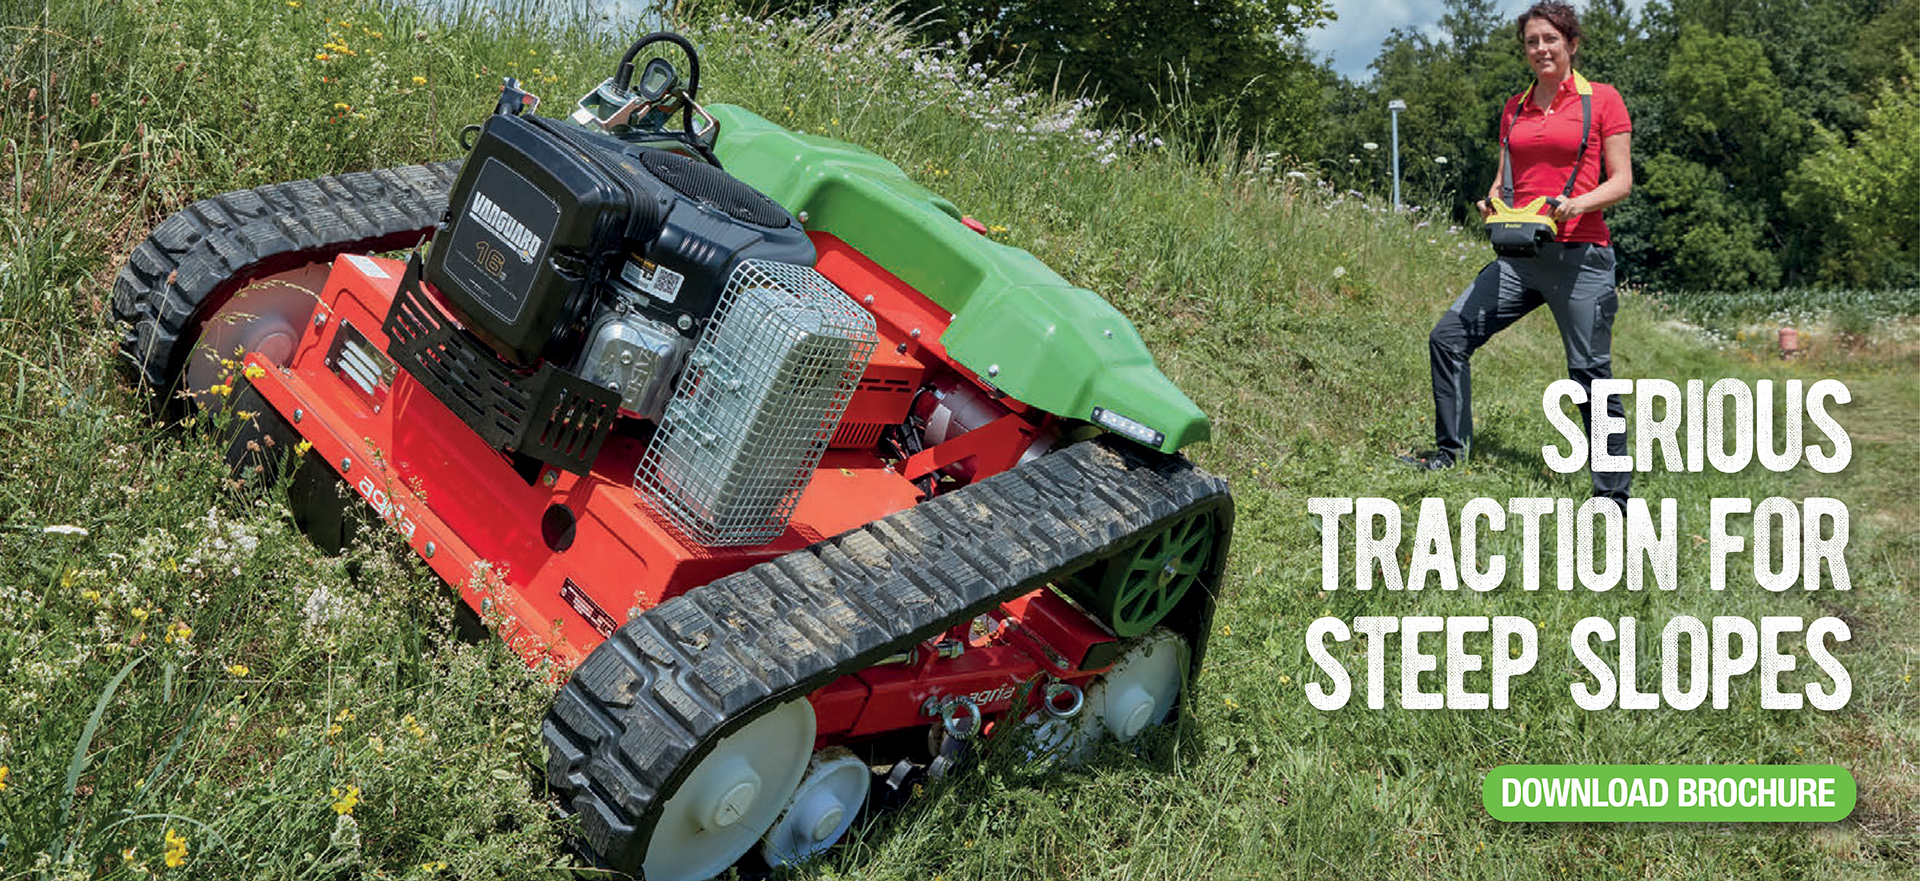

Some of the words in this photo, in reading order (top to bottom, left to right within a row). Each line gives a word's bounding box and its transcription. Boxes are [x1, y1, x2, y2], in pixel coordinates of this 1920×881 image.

[471, 191, 542, 258] VANGUARD
[476, 241, 506, 277] 16
[359, 475, 416, 538] agria
[969, 682, 1016, 706] agria
